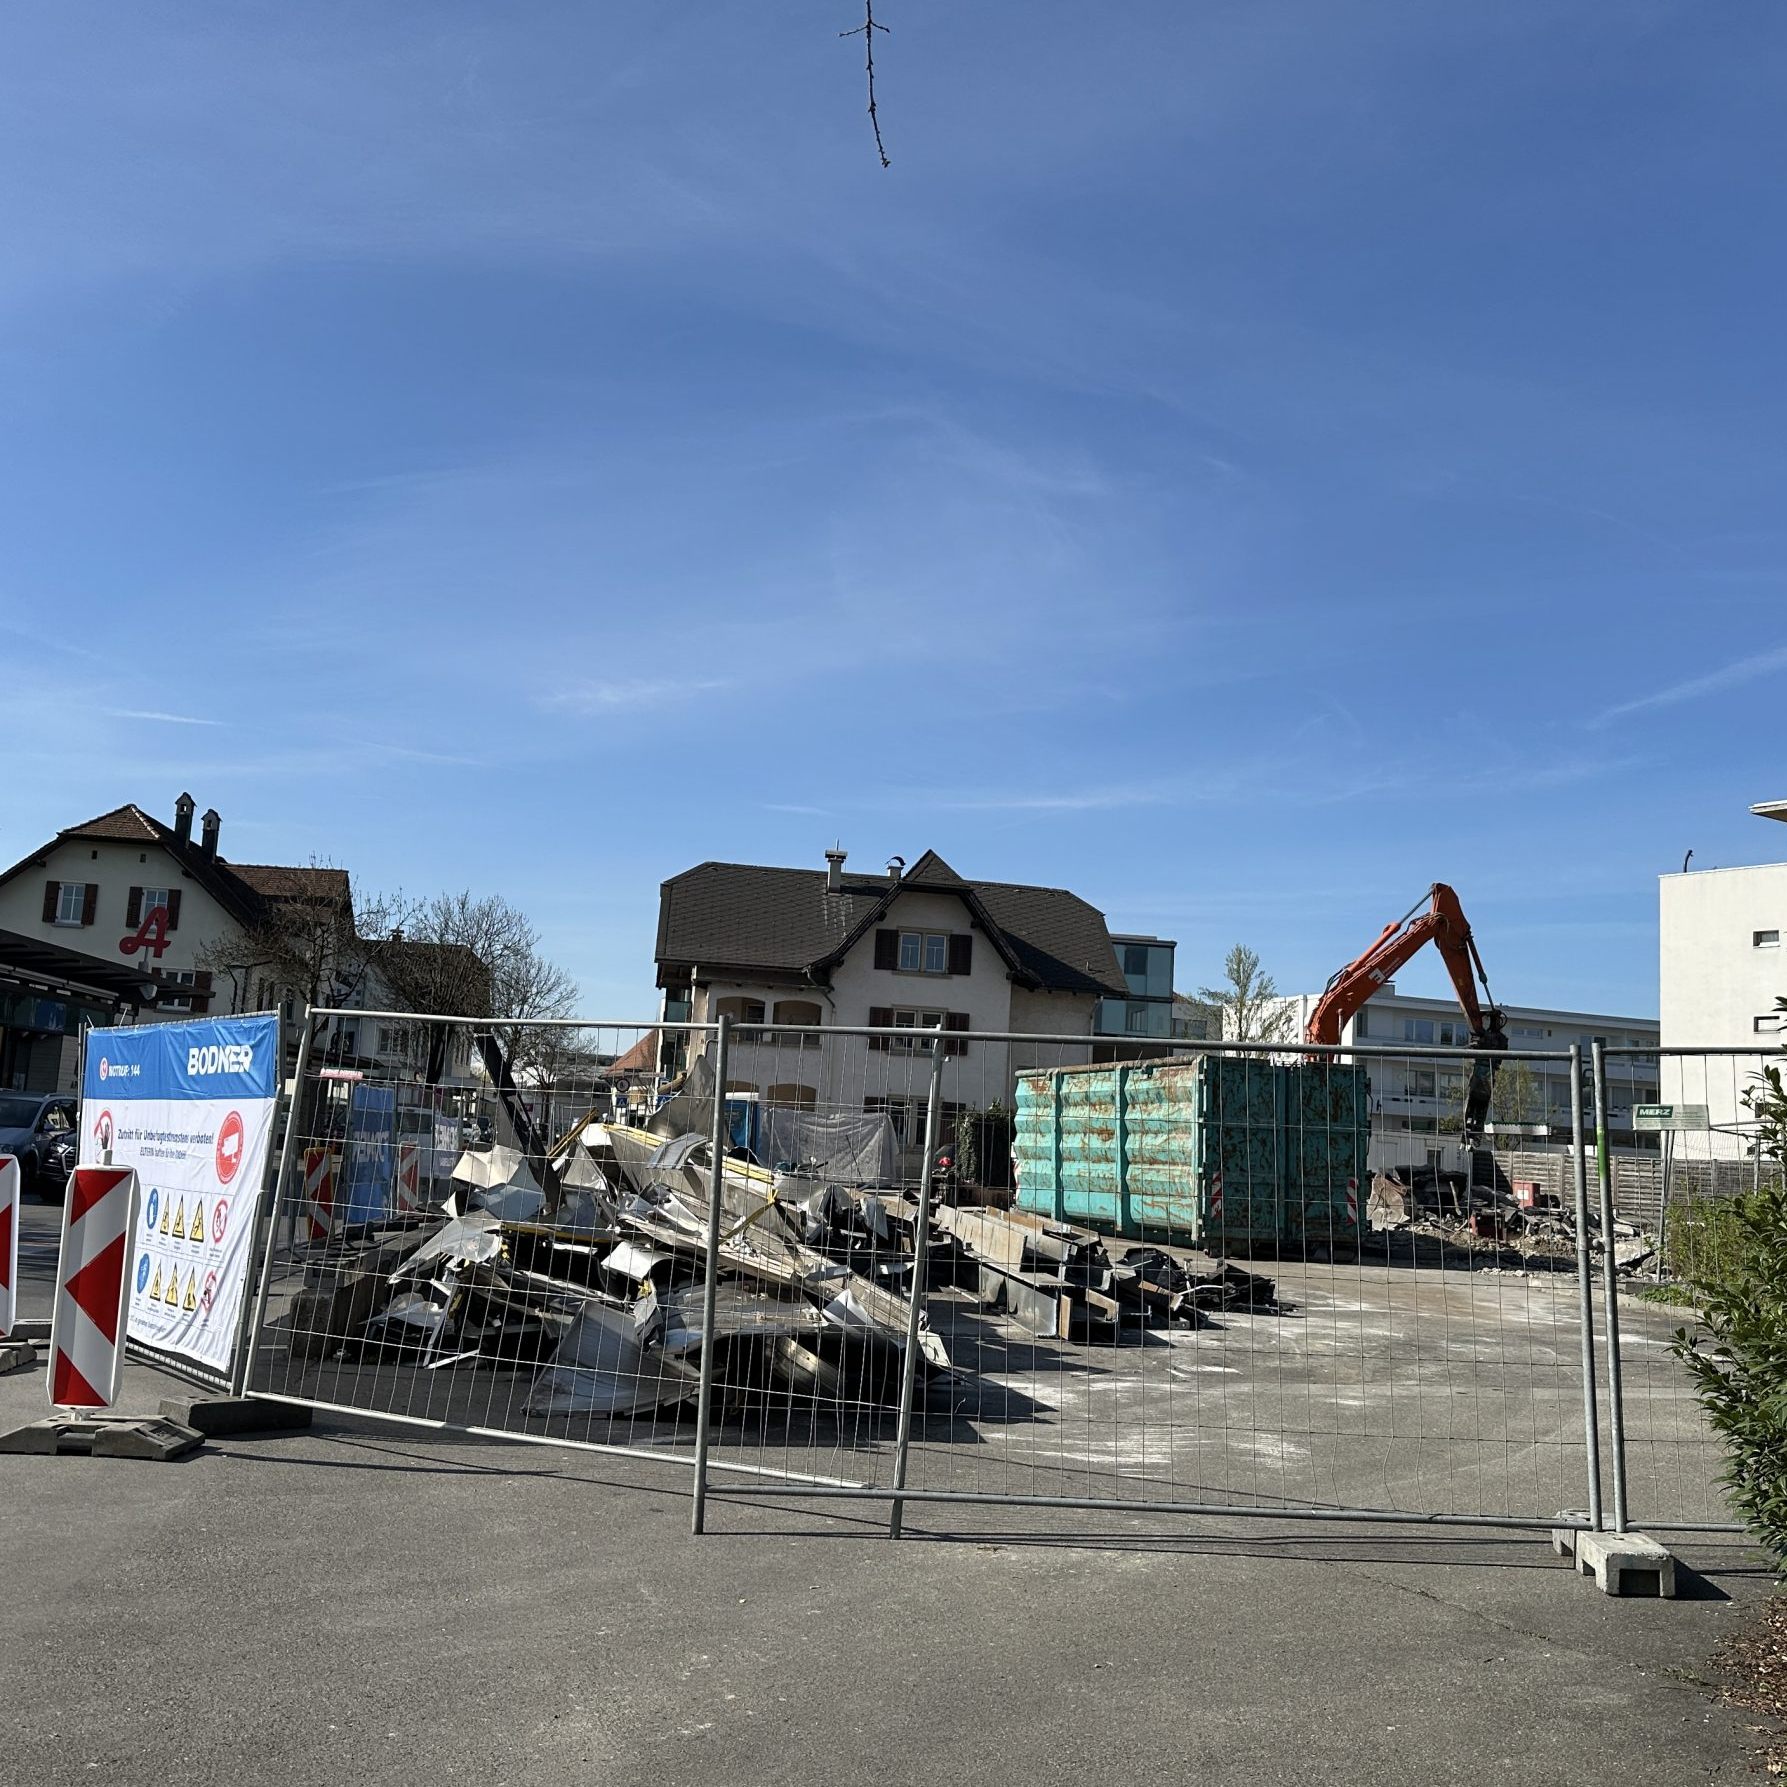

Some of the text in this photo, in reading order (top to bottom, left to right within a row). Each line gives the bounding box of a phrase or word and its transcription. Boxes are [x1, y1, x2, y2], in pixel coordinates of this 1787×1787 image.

[119, 906, 171, 958] A
[187, 1044, 253, 1076] BODNER
[130, 1064, 140, 1077] 144
[1639, 1108, 1671, 1116] MERZ
[135, 1128, 143, 1140] für
